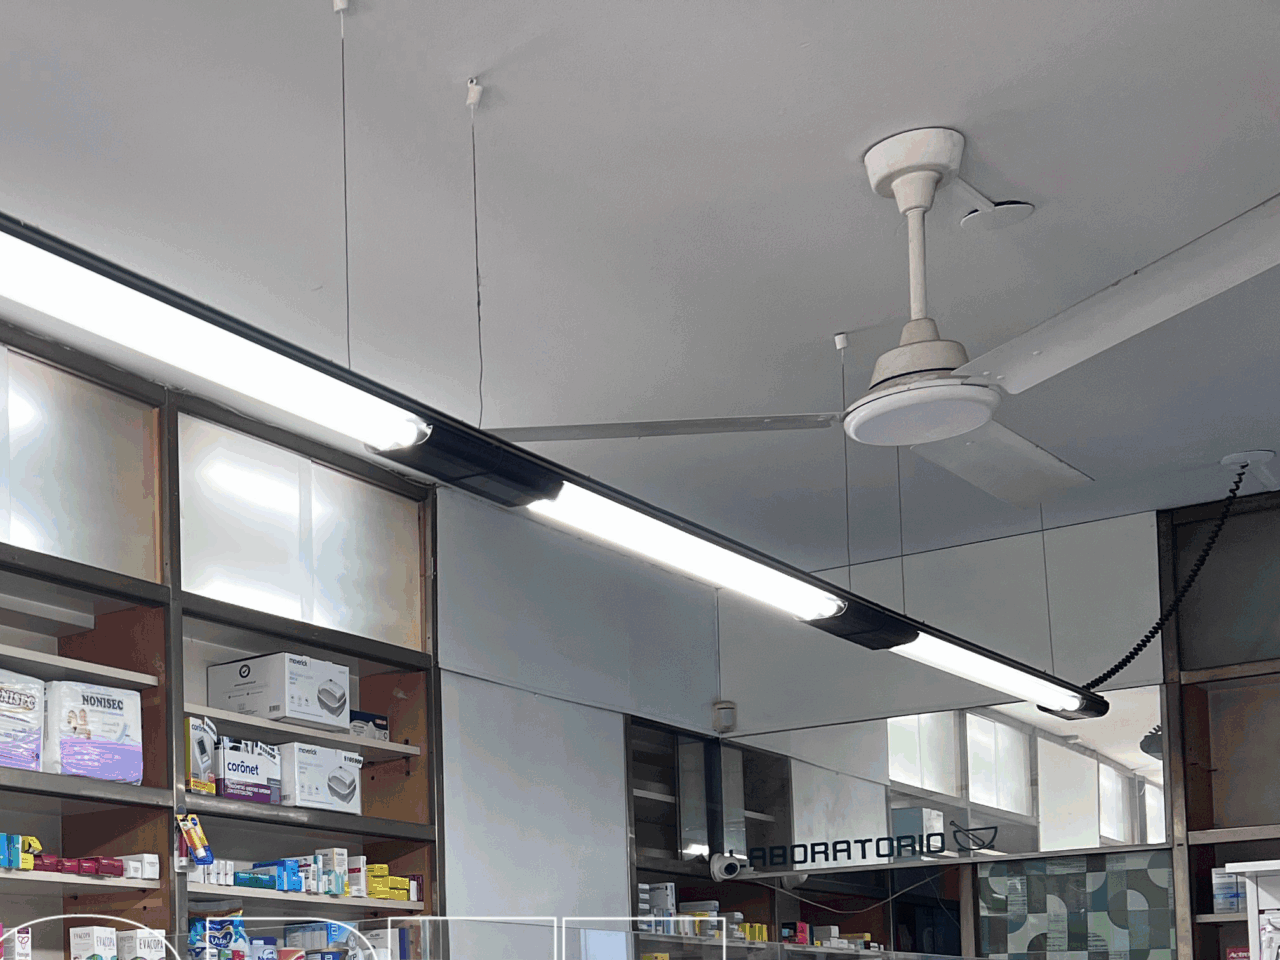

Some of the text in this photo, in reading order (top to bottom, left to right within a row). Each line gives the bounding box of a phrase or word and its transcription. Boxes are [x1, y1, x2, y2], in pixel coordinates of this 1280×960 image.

[81, 694, 124, 710] NONISEC
[227, 760, 259, 776] corônet
[139, 939, 164, 949] EVACOPA
